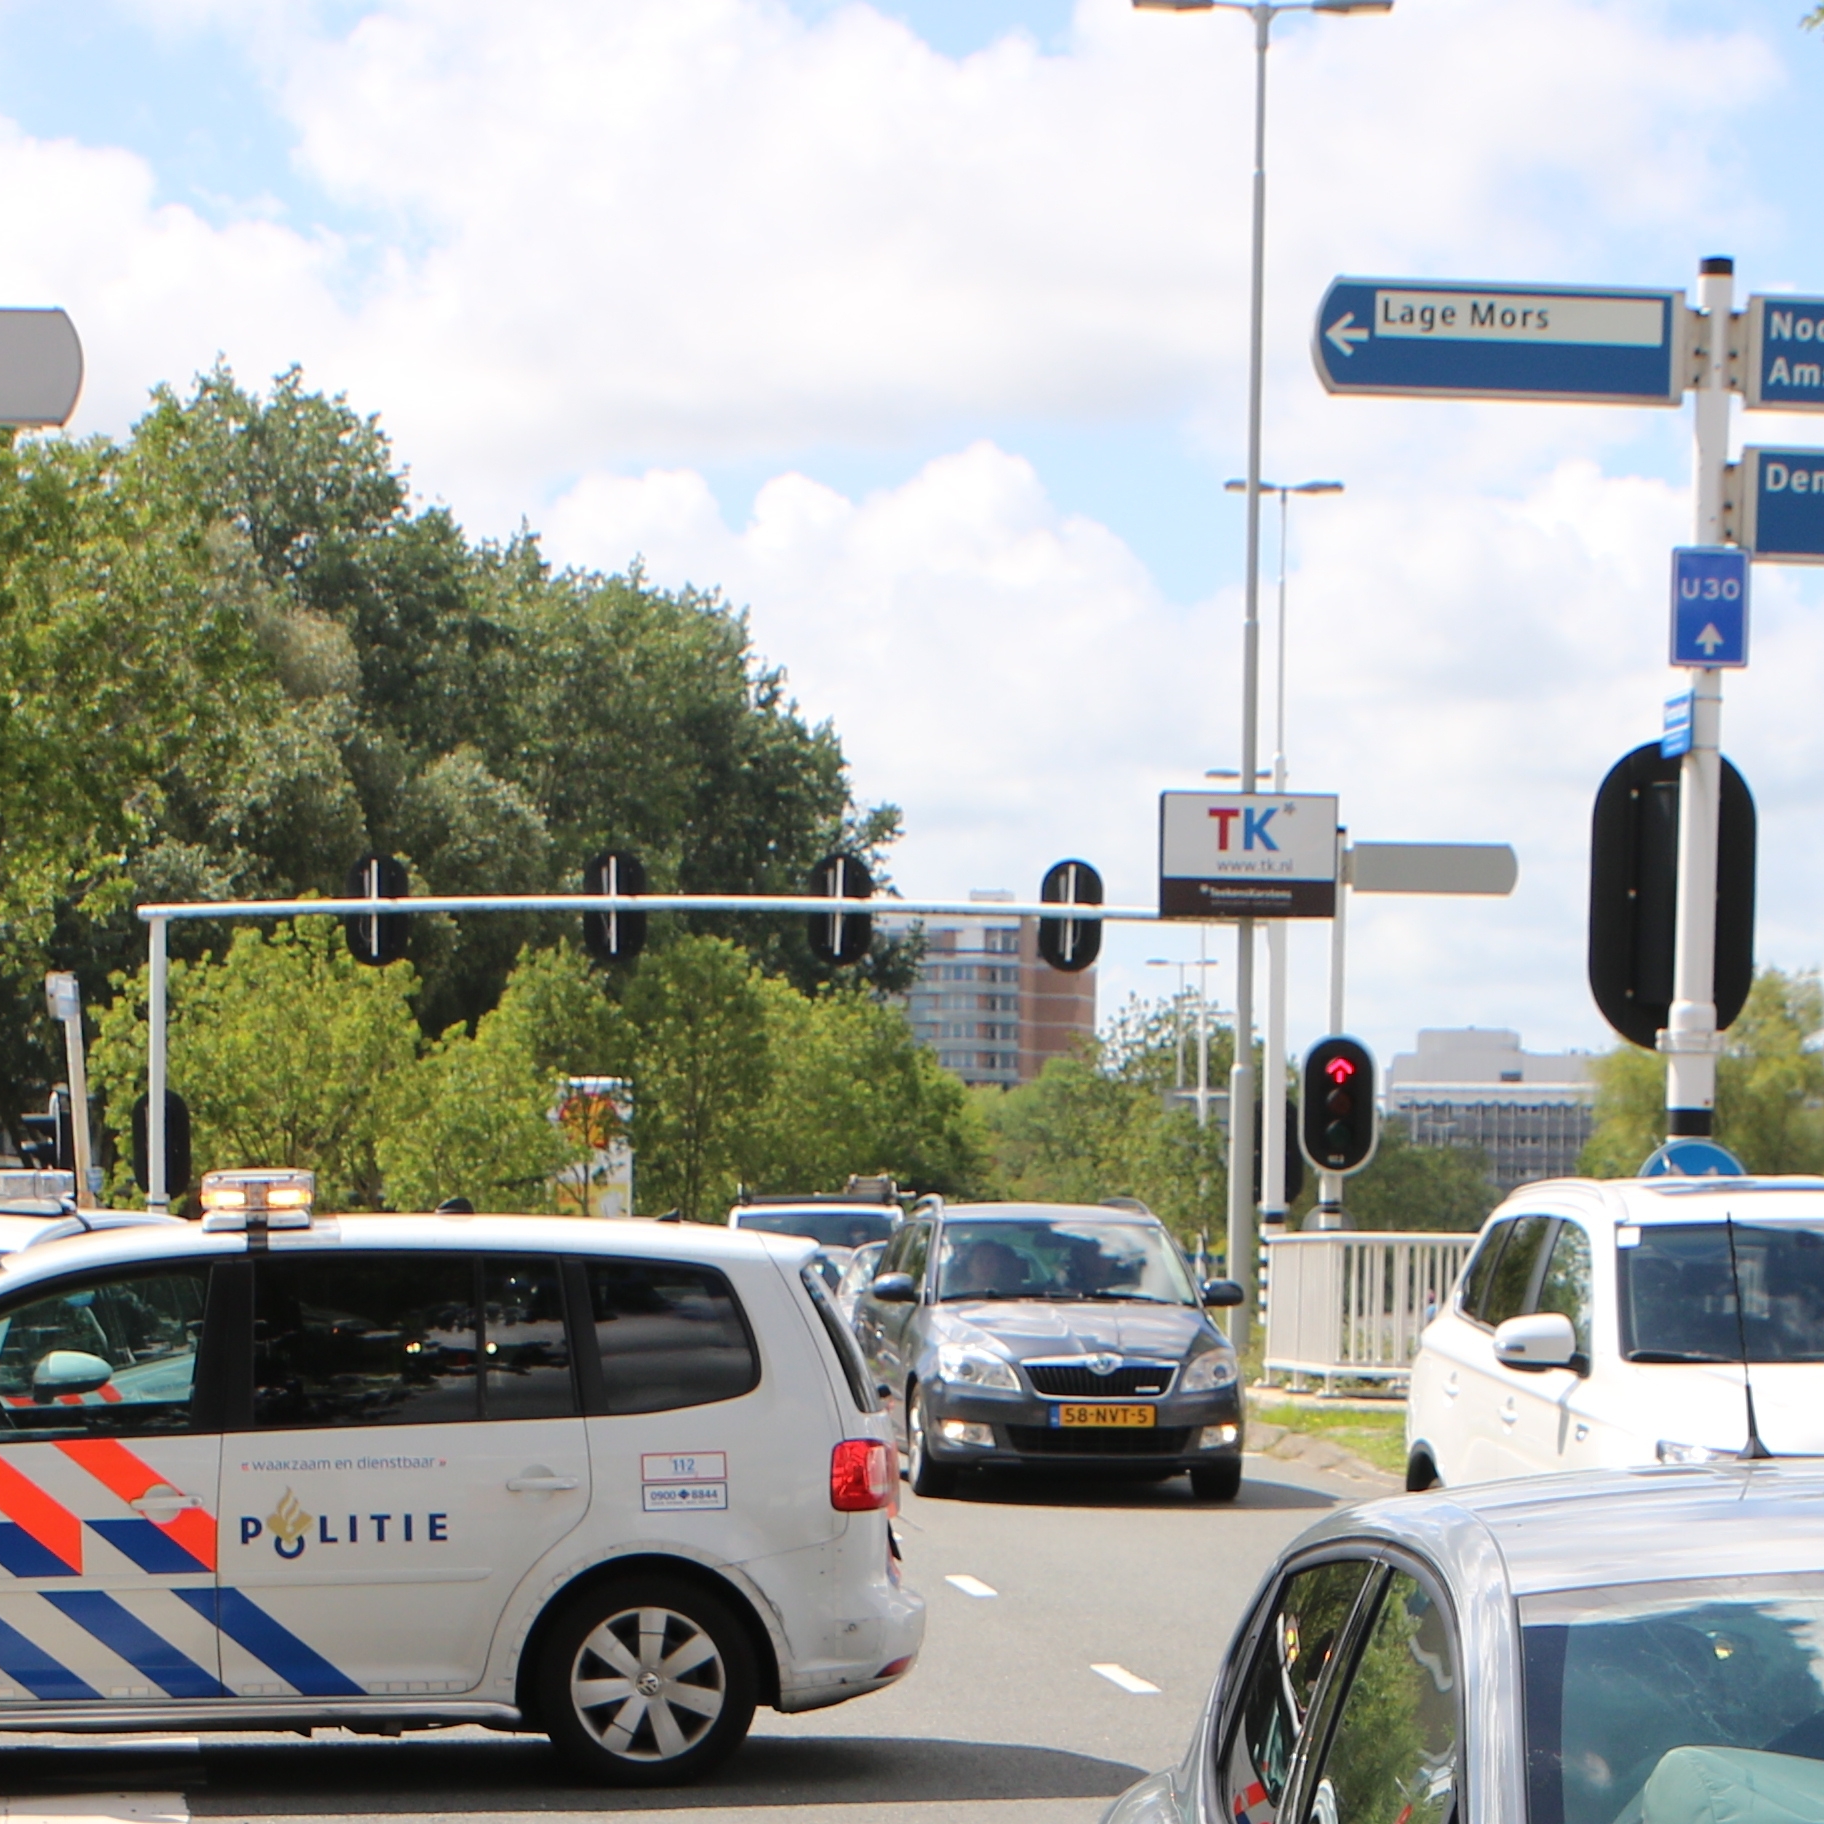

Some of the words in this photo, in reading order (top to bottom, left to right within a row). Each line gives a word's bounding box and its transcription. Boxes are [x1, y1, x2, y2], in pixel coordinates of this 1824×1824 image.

[1383, 299, 1456, 331] Lage
[1471, 302, 1549, 330] Mors
[1681, 577, 1740, 600] U30
[1217, 859, 1293, 873] www.tk.nl
[1065, 1407, 1148, 1424] 58-NVT-5
[252, 1458, 331, 1471] waakzaam
[335, 1458, 352, 1470] en
[357, 1456, 435, 1470] dienstbaar
[673, 1458, 695, 1471] 112
[650, 1490, 676, 1501] 0900
[240, 1512, 448, 1559] POLITIE
